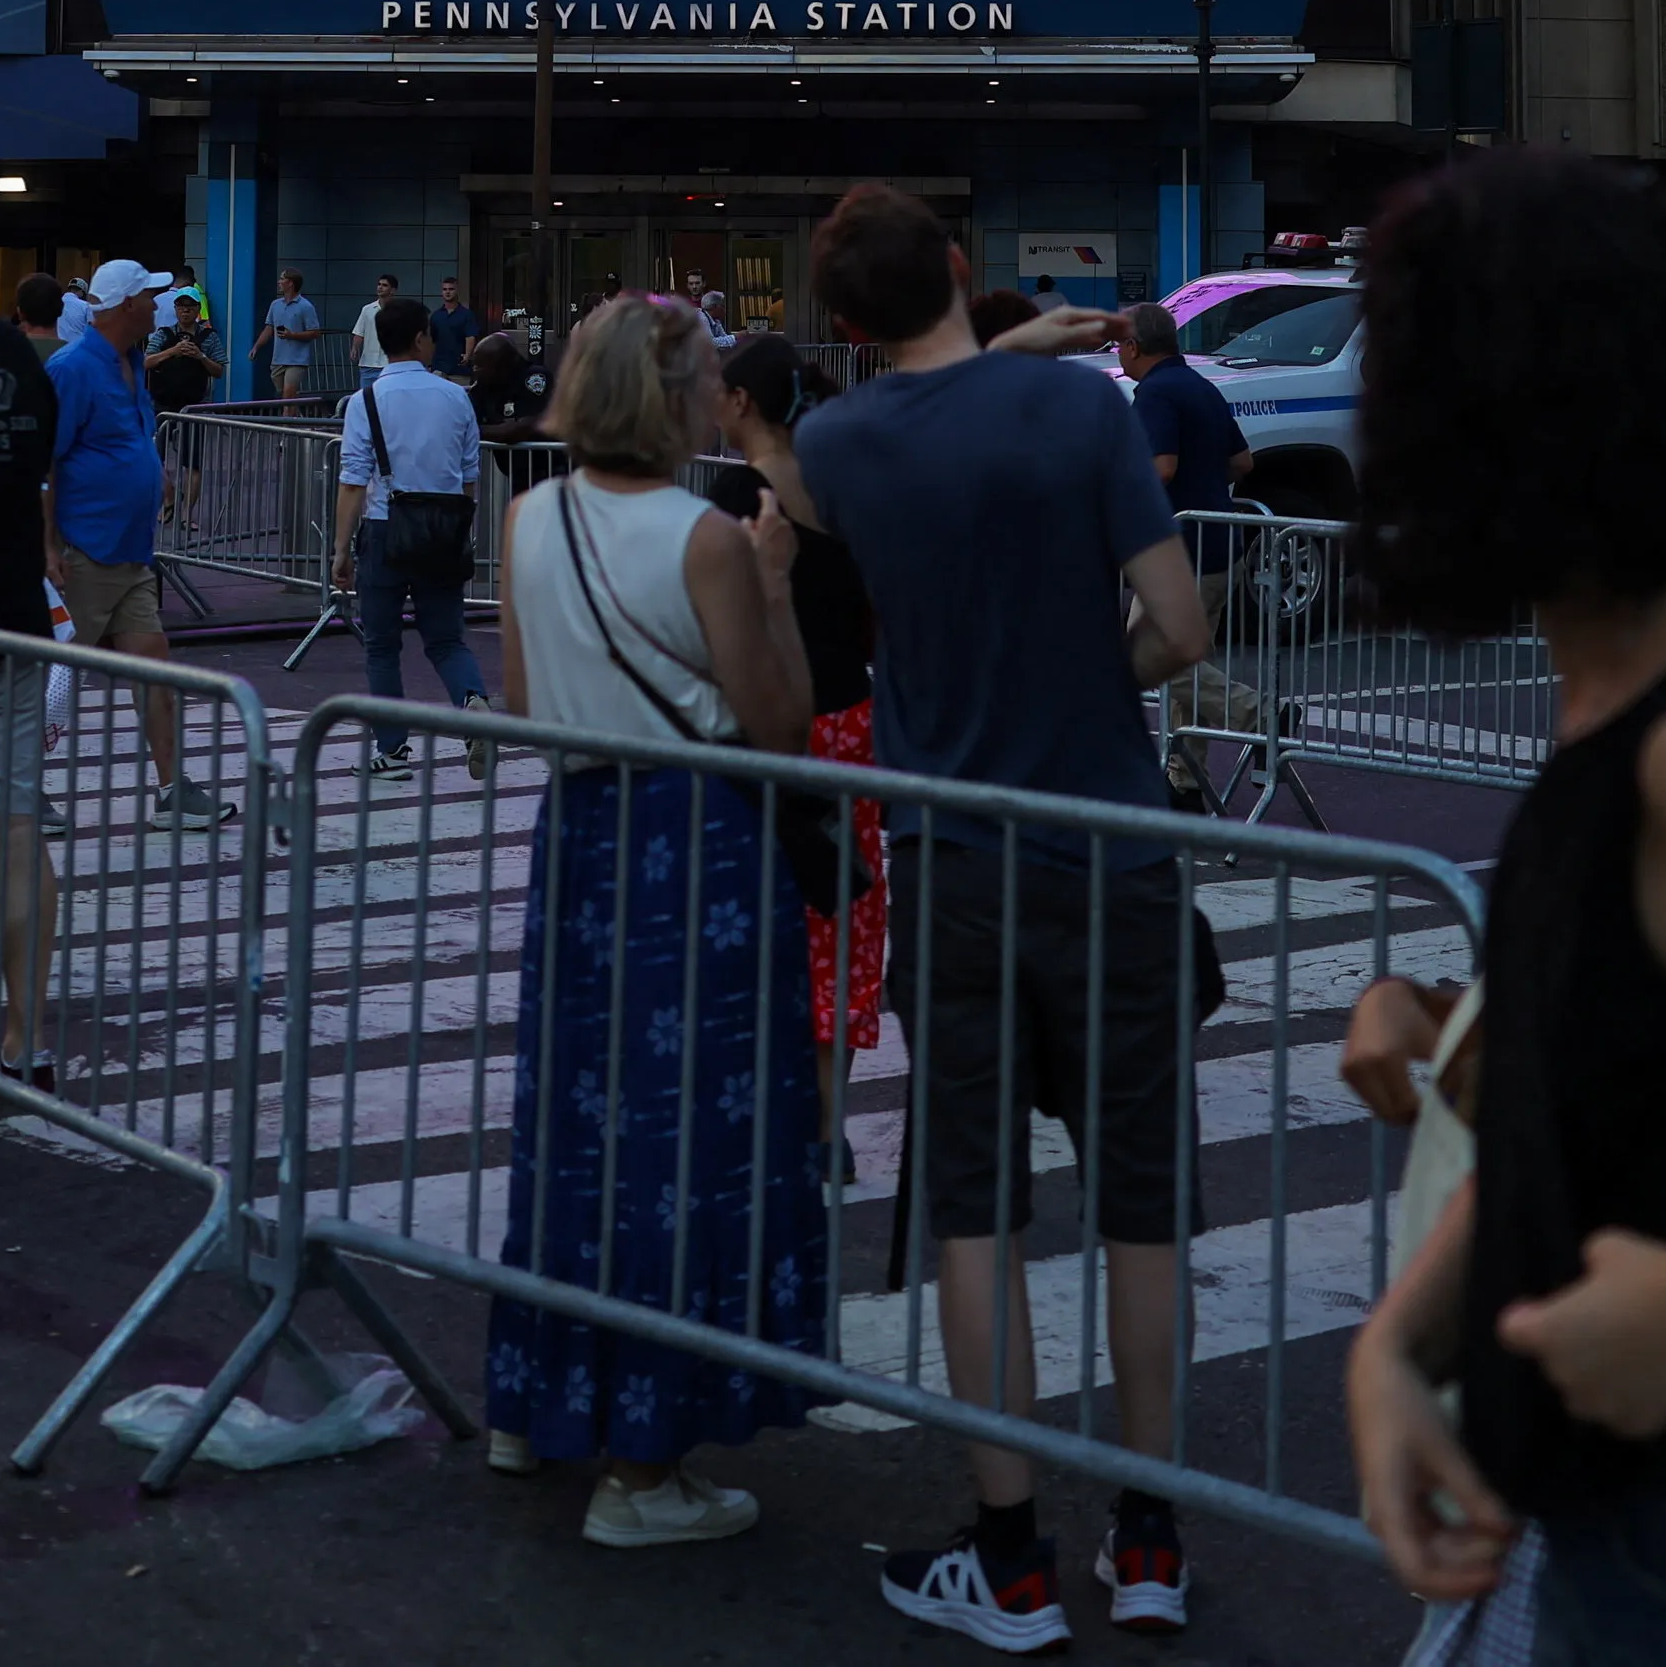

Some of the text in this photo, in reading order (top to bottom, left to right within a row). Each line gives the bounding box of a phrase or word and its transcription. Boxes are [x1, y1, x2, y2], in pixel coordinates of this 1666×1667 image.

[381, 0, 1014, 32] PENNSYLVANIA STATION
[1235, 400, 1277, 418] POLICE
